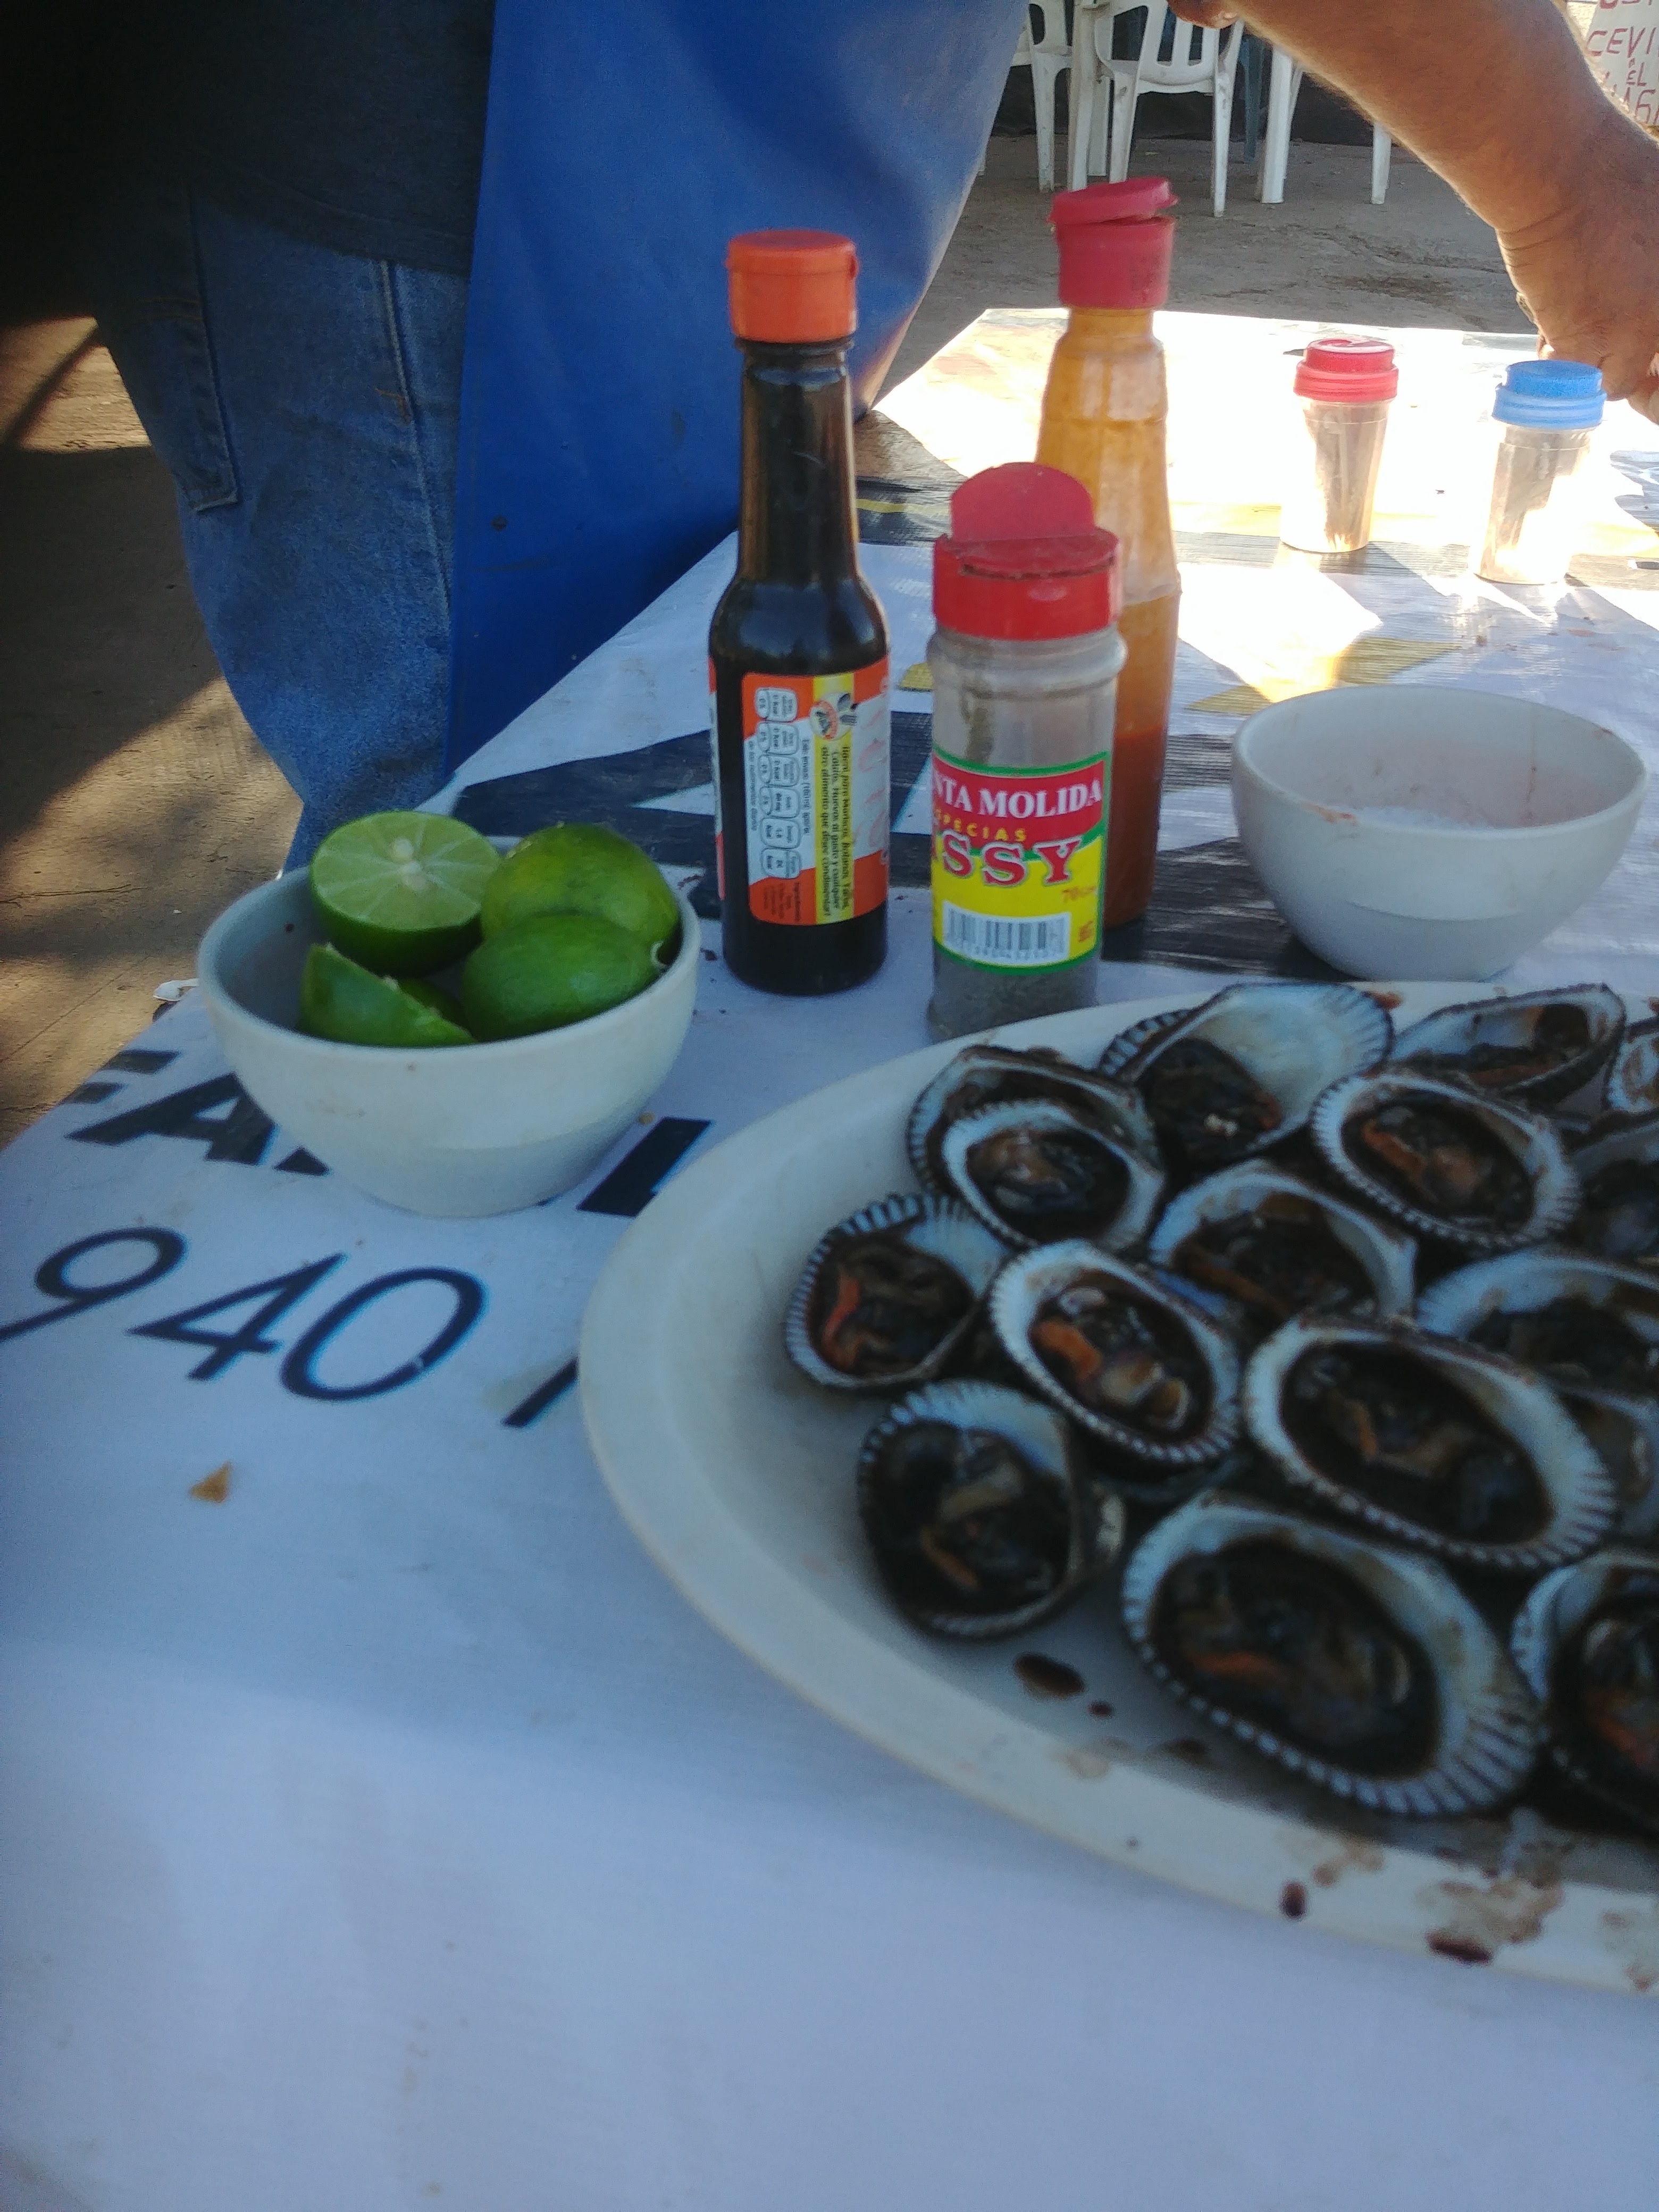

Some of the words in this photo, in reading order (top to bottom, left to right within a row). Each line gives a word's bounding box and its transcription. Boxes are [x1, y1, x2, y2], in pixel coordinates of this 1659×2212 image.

[1586, 26, 1659, 57] CEVI
[978, 779, 1103, 819] MOLIDA
[0, 1226, 487, 1401] 940
